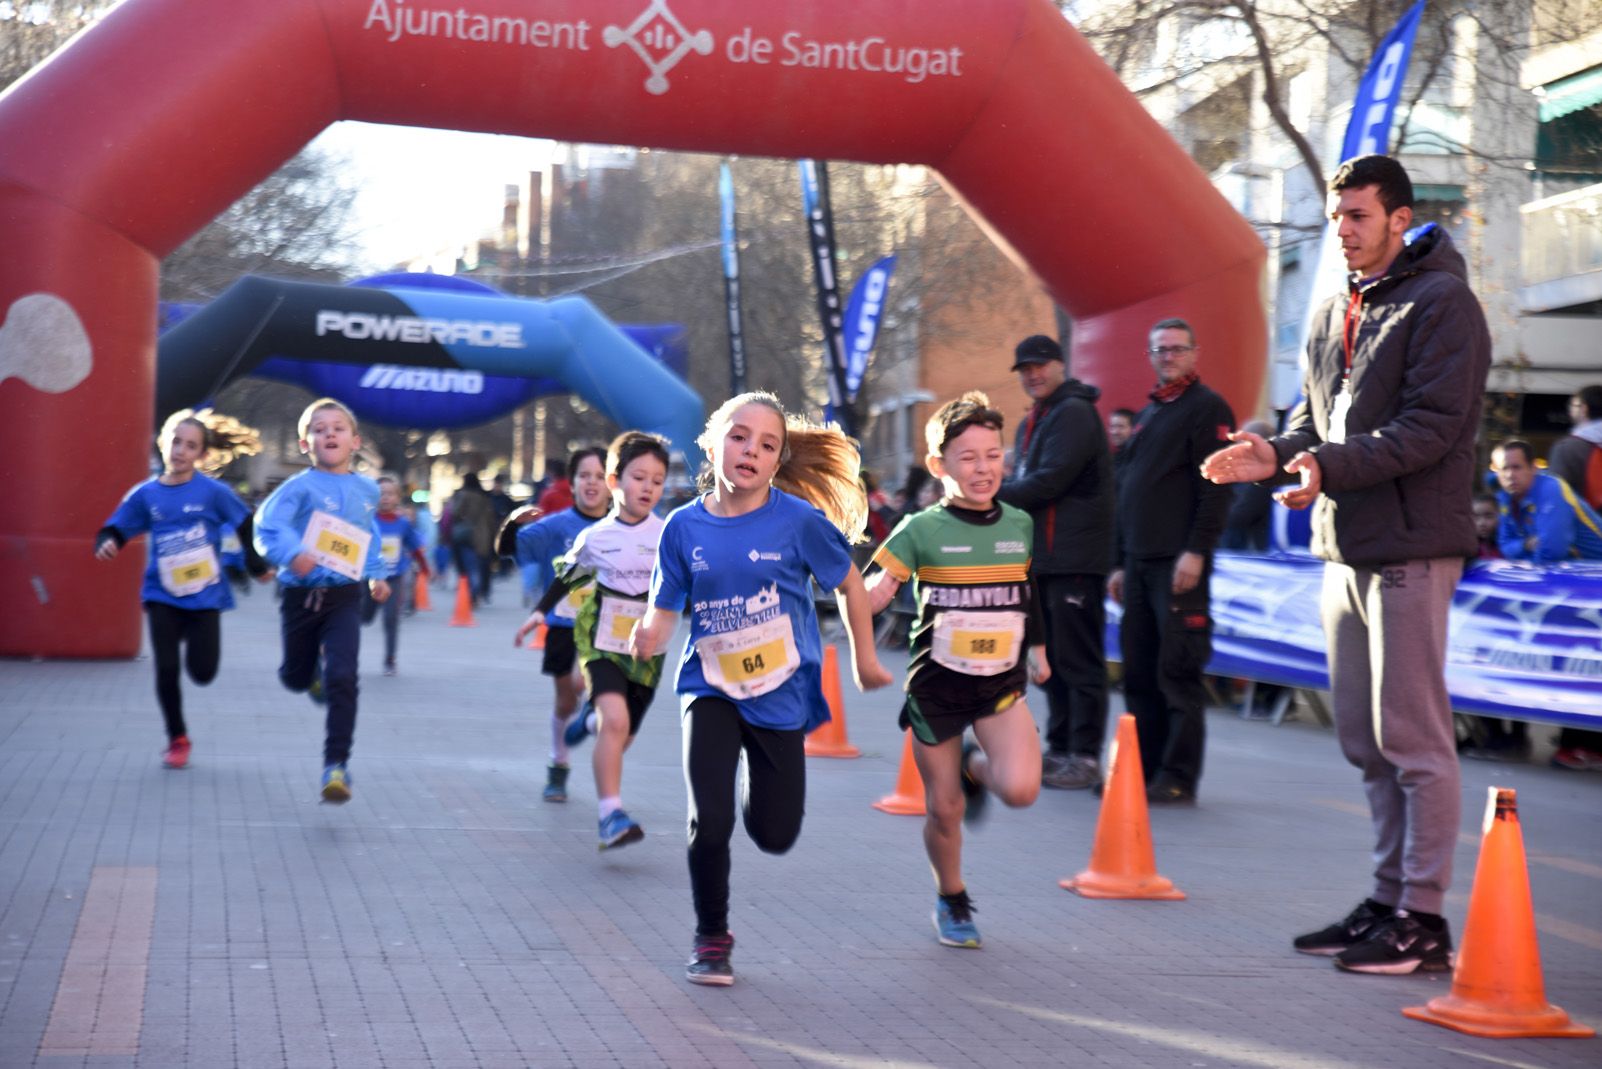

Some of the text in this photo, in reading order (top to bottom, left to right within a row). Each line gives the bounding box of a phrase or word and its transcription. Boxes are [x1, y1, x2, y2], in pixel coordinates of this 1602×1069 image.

[364, 0, 963, 83] Ajuntament de SantCugat
[316, 310, 525, 349] POWERADE
[1383, 569, 1407, 589] 92
[742, 653, 765, 674] 64
